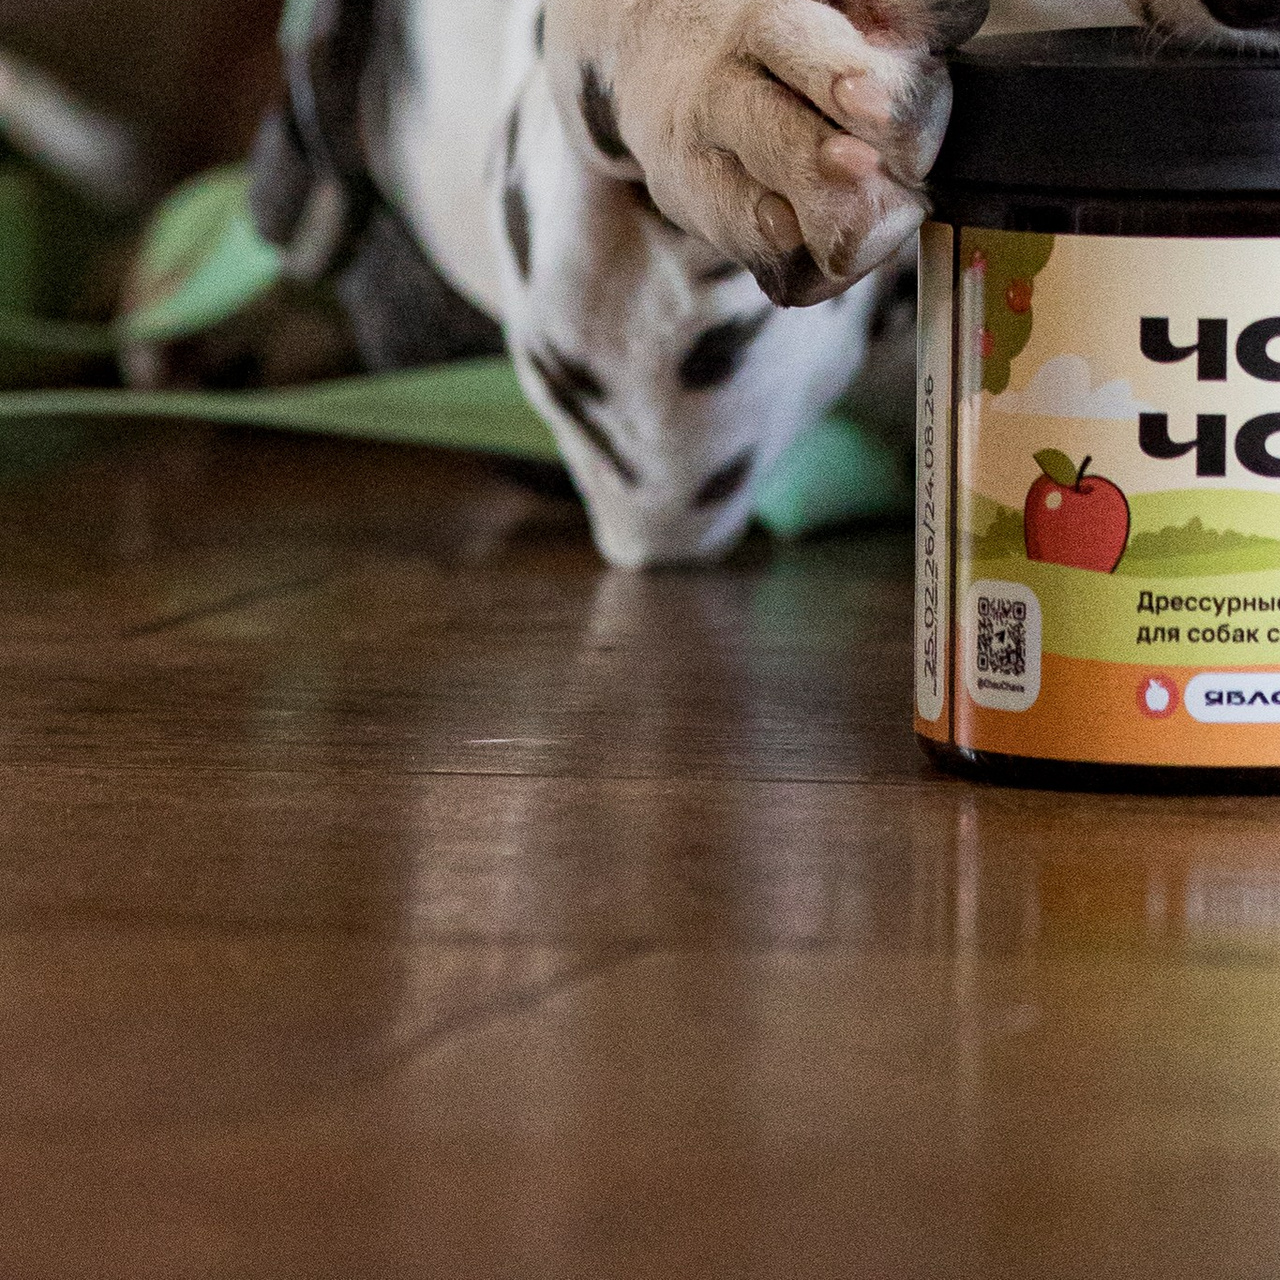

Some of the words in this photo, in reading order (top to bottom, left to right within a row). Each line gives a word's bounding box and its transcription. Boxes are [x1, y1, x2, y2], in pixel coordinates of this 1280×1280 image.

[924, 374, 937, 679] 25.02.26/24.08.26
[1136, 625, 1180, 644] для
[1187, 623, 1259, 643] собак
[1267, 627, 1280, 642] с
